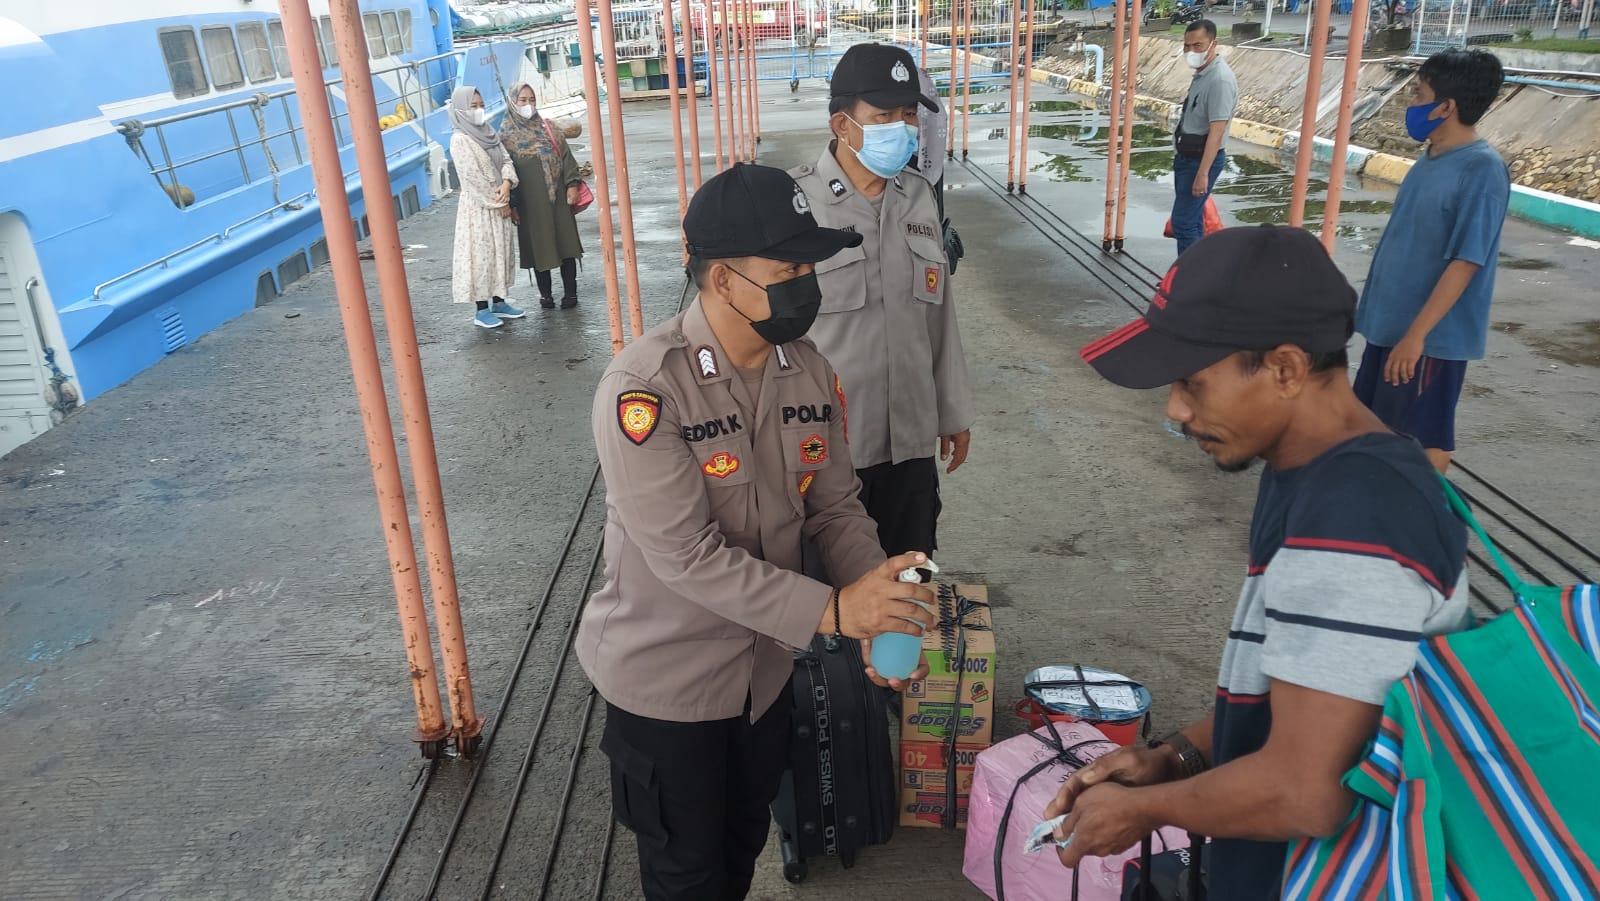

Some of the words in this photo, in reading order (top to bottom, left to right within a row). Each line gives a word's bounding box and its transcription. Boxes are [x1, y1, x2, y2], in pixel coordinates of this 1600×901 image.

[911, 682, 920, 693] 8
[815, 685, 830, 743] POLO
[904, 750, 928, 767] 40
[820, 749, 834, 806] SWISS
[908, 773, 917, 784] 8
